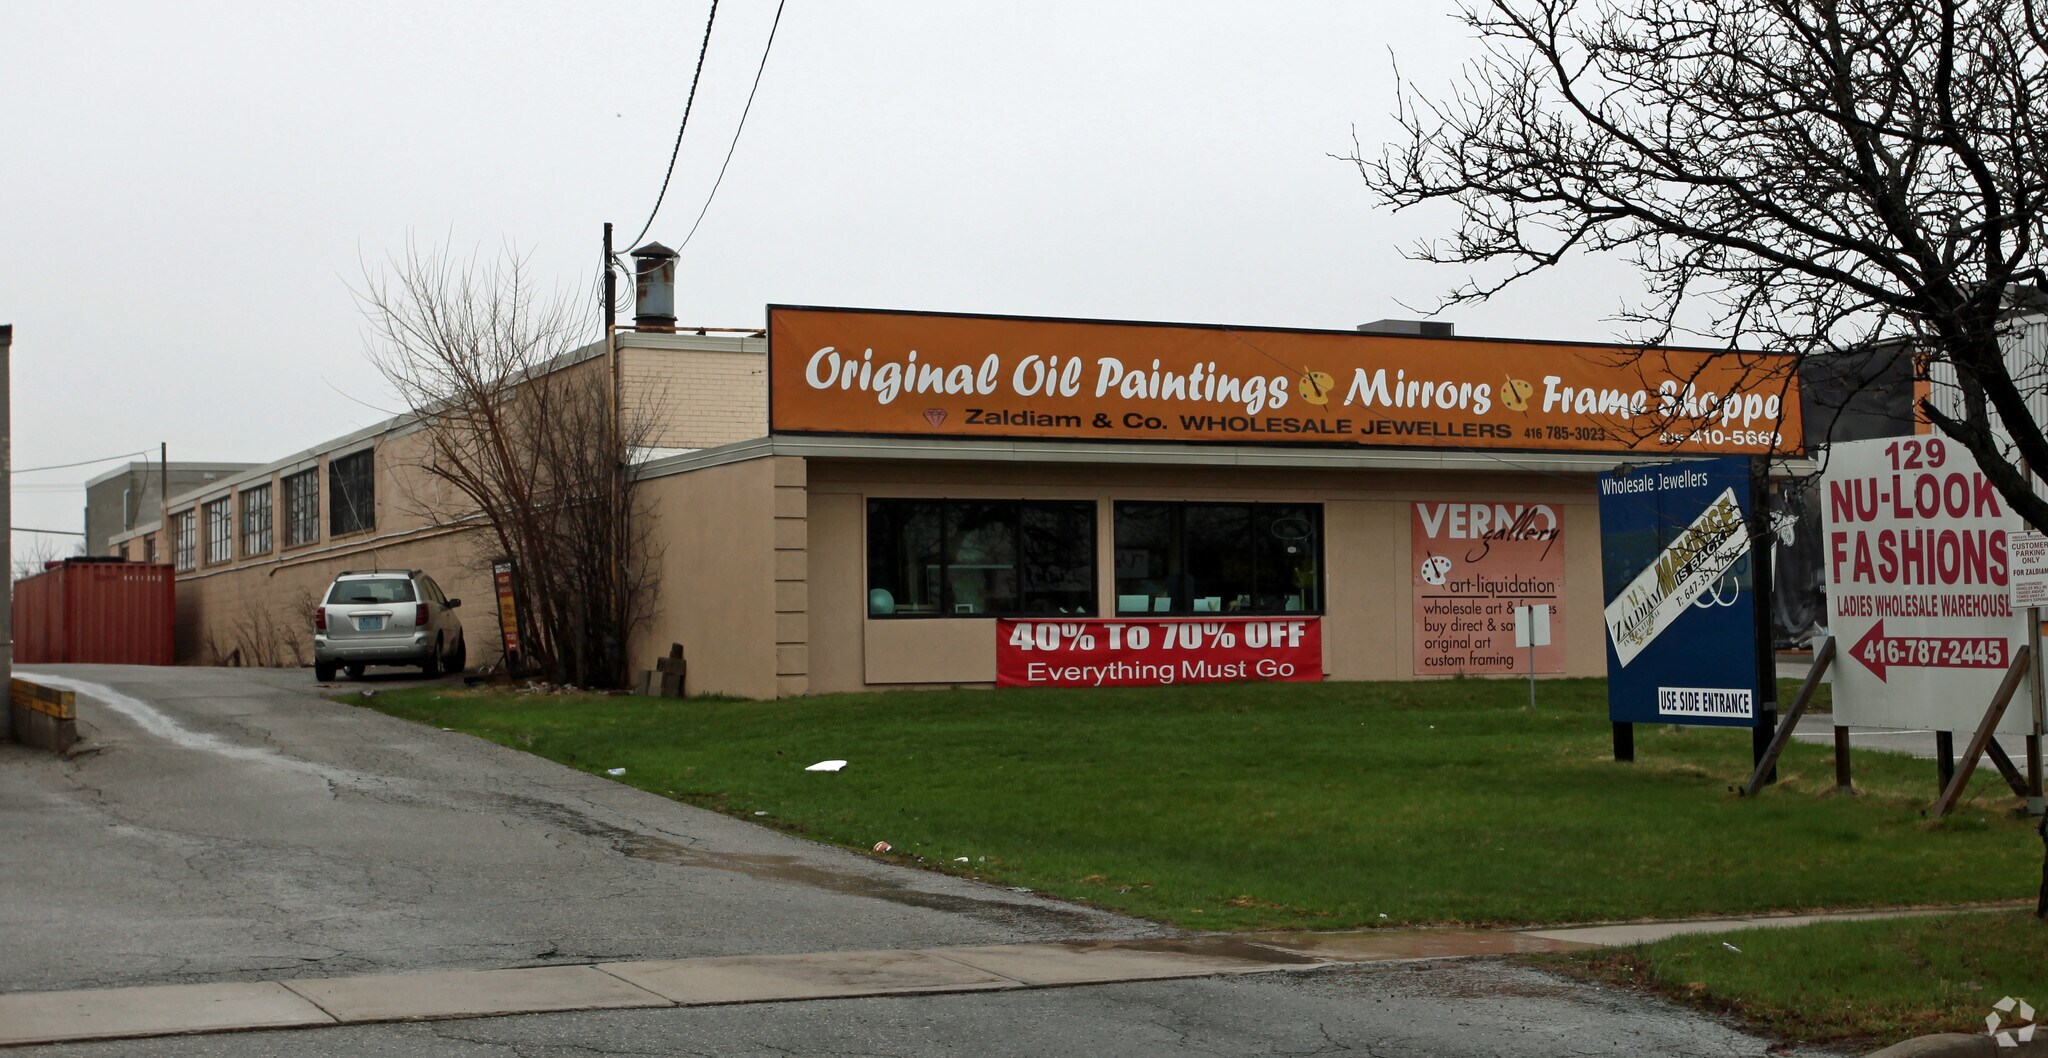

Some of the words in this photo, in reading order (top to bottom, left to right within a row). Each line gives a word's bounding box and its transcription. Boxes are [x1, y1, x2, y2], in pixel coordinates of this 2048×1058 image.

[805, 345, 999, 405] Original
[1012, 354, 1082, 398] Oil
[1094, 356, 1289, 416] Paintings
[1343, 367, 1492, 415] Mirrors
[1542, 375, 1648, 420] Frame
[1658, 379, 1781, 428] Shoppe
[964, 408, 1083, 429] Zaldiam
[1092, 411, 1114, 430] &
[1123, 412, 1168, 431] Co.
[1179, 415, 1353, 435] WHOLESALE
[1360, 420, 1513, 439] JEWELLERS
[1524, 427, 1542, 440] 416
[1546, 425, 1606, 442] 785-3023
[1689, 429, 1783, 447] 410-5669
[1885, 438, 1946, 471] 129
[1601, 474, 1655, 496] Wholesale
[1658, 471, 1709, 491] Jewellers
[1830, 472, 2002, 523] NU-LOOK
[1416, 503, 1557, 541] VERNO
[1465, 507, 1561, 563] gallery
[1654, 496, 1739, 599] MAURICE
[1831, 528, 2009, 587] FASHIONS
[2012, 542, 2048, 550] CUSTOMER
[2015, 549, 2046, 557] PARKING
[1675, 568, 1689, 585] IS
[1690, 534, 1725, 570] BACK
[1450, 574, 1555, 598] art-liquidation
[2013, 569, 2025, 577] FOR
[1424, 600, 1482, 615] wholesale
[1486, 603, 1502, 615] art
[1506, 601, 1516, 615] &
[1676, 597, 1684, 608] T:
[1837, 595, 1873, 618] LADIES
[1875, 594, 1938, 617] WHOLESALE
[1940, 593, 2013, 618] WAREHOUSE
[1424, 617, 1447, 636] buy
[1450, 618, 1483, 632] direct
[1487, 619, 1497, 632] &
[1612, 591, 1662, 643] ZALDIAM
[1009, 622, 1096, 651] 40%
[1159, 621, 1236, 650] 70%
[1244, 621, 1306, 649] OFF
[1424, 633, 1471, 653] original
[1474, 637, 1492, 649] art
[1424, 654, 1465, 667] custom
[1469, 650, 1514, 670] framing
[1863, 639, 2002, 666] 416-787-2445
[1027, 661, 1175, 687] Everything
[1181, 659, 1247, 680] Must
[1255, 658, 1295, 678] Go
[1660, 690, 1679, 711] USE
[1679, 691, 1700, 712] SIDE
[1702, 691, 1750, 714] ENTRANCE
